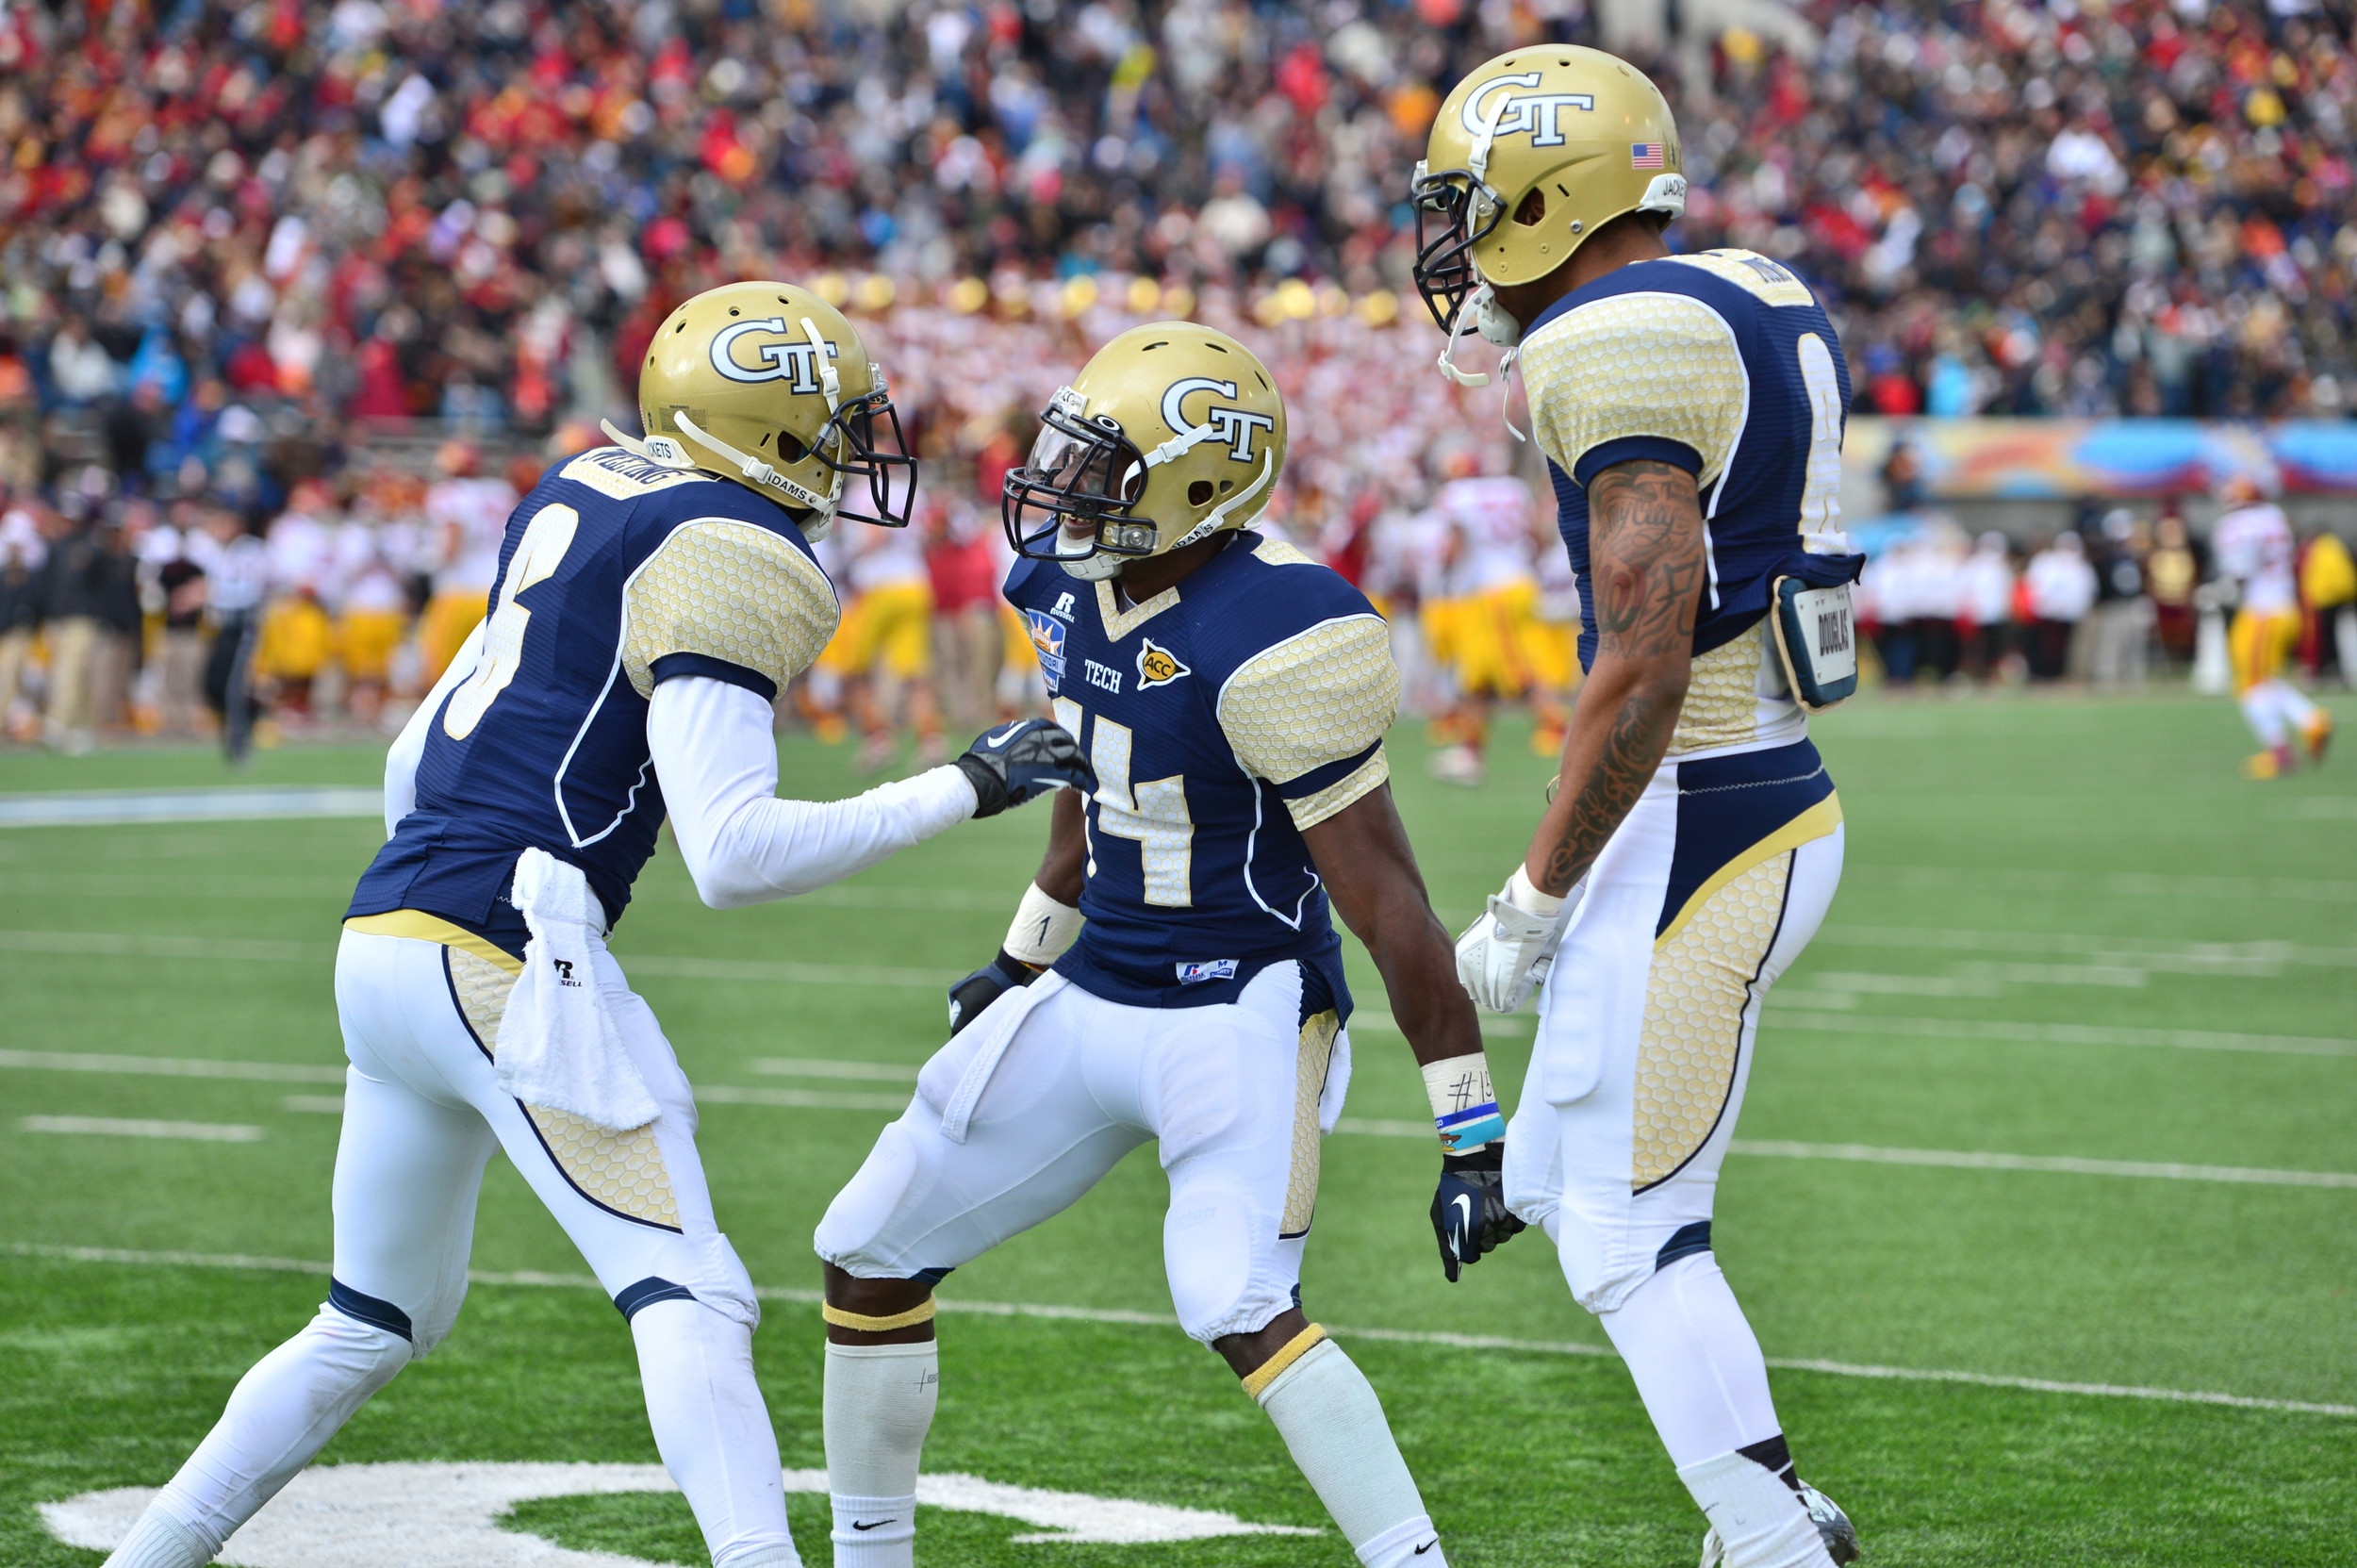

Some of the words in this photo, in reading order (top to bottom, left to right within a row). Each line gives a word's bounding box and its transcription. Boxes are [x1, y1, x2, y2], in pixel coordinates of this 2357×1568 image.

[1461, 72, 1594, 148] GT
[709, 317, 838, 396] GT
[1161, 377, 1273, 464] GT
[1084, 659, 1123, 694] TECH
[1145, 656, 1171, 677] ACC
